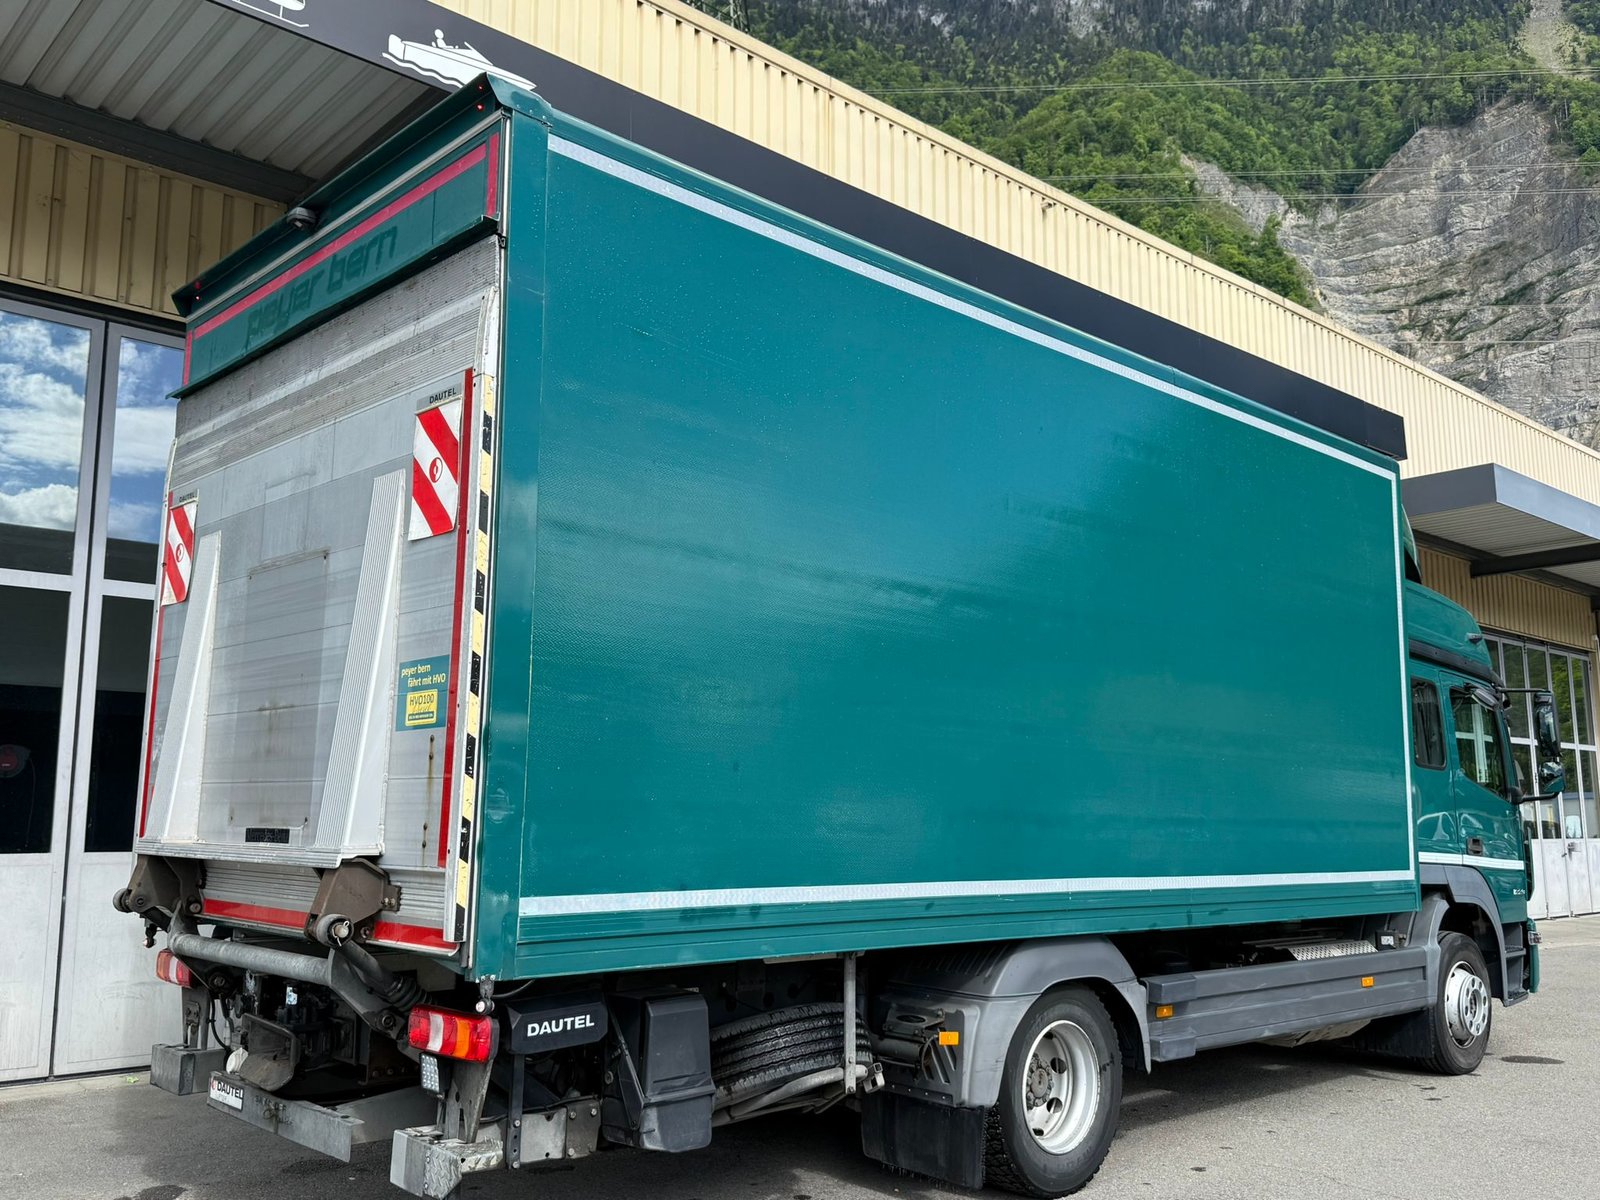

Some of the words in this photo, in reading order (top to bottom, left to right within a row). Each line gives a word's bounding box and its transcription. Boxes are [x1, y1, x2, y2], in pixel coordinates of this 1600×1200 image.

[327, 226, 398, 293] bern
[429, 387, 456, 404] DAUTEL
[401, 666, 416, 678] peyer
[418, 664, 431, 673] bern
[408, 678, 421, 688] fährt
[422, 676, 432, 685] mit
[433, 673, 446, 684] HVO
[409, 693, 435, 706] HVO100
[527, 1014, 595, 1037] DAUTEL
[217, 1081, 243, 1100] DAUTEL
